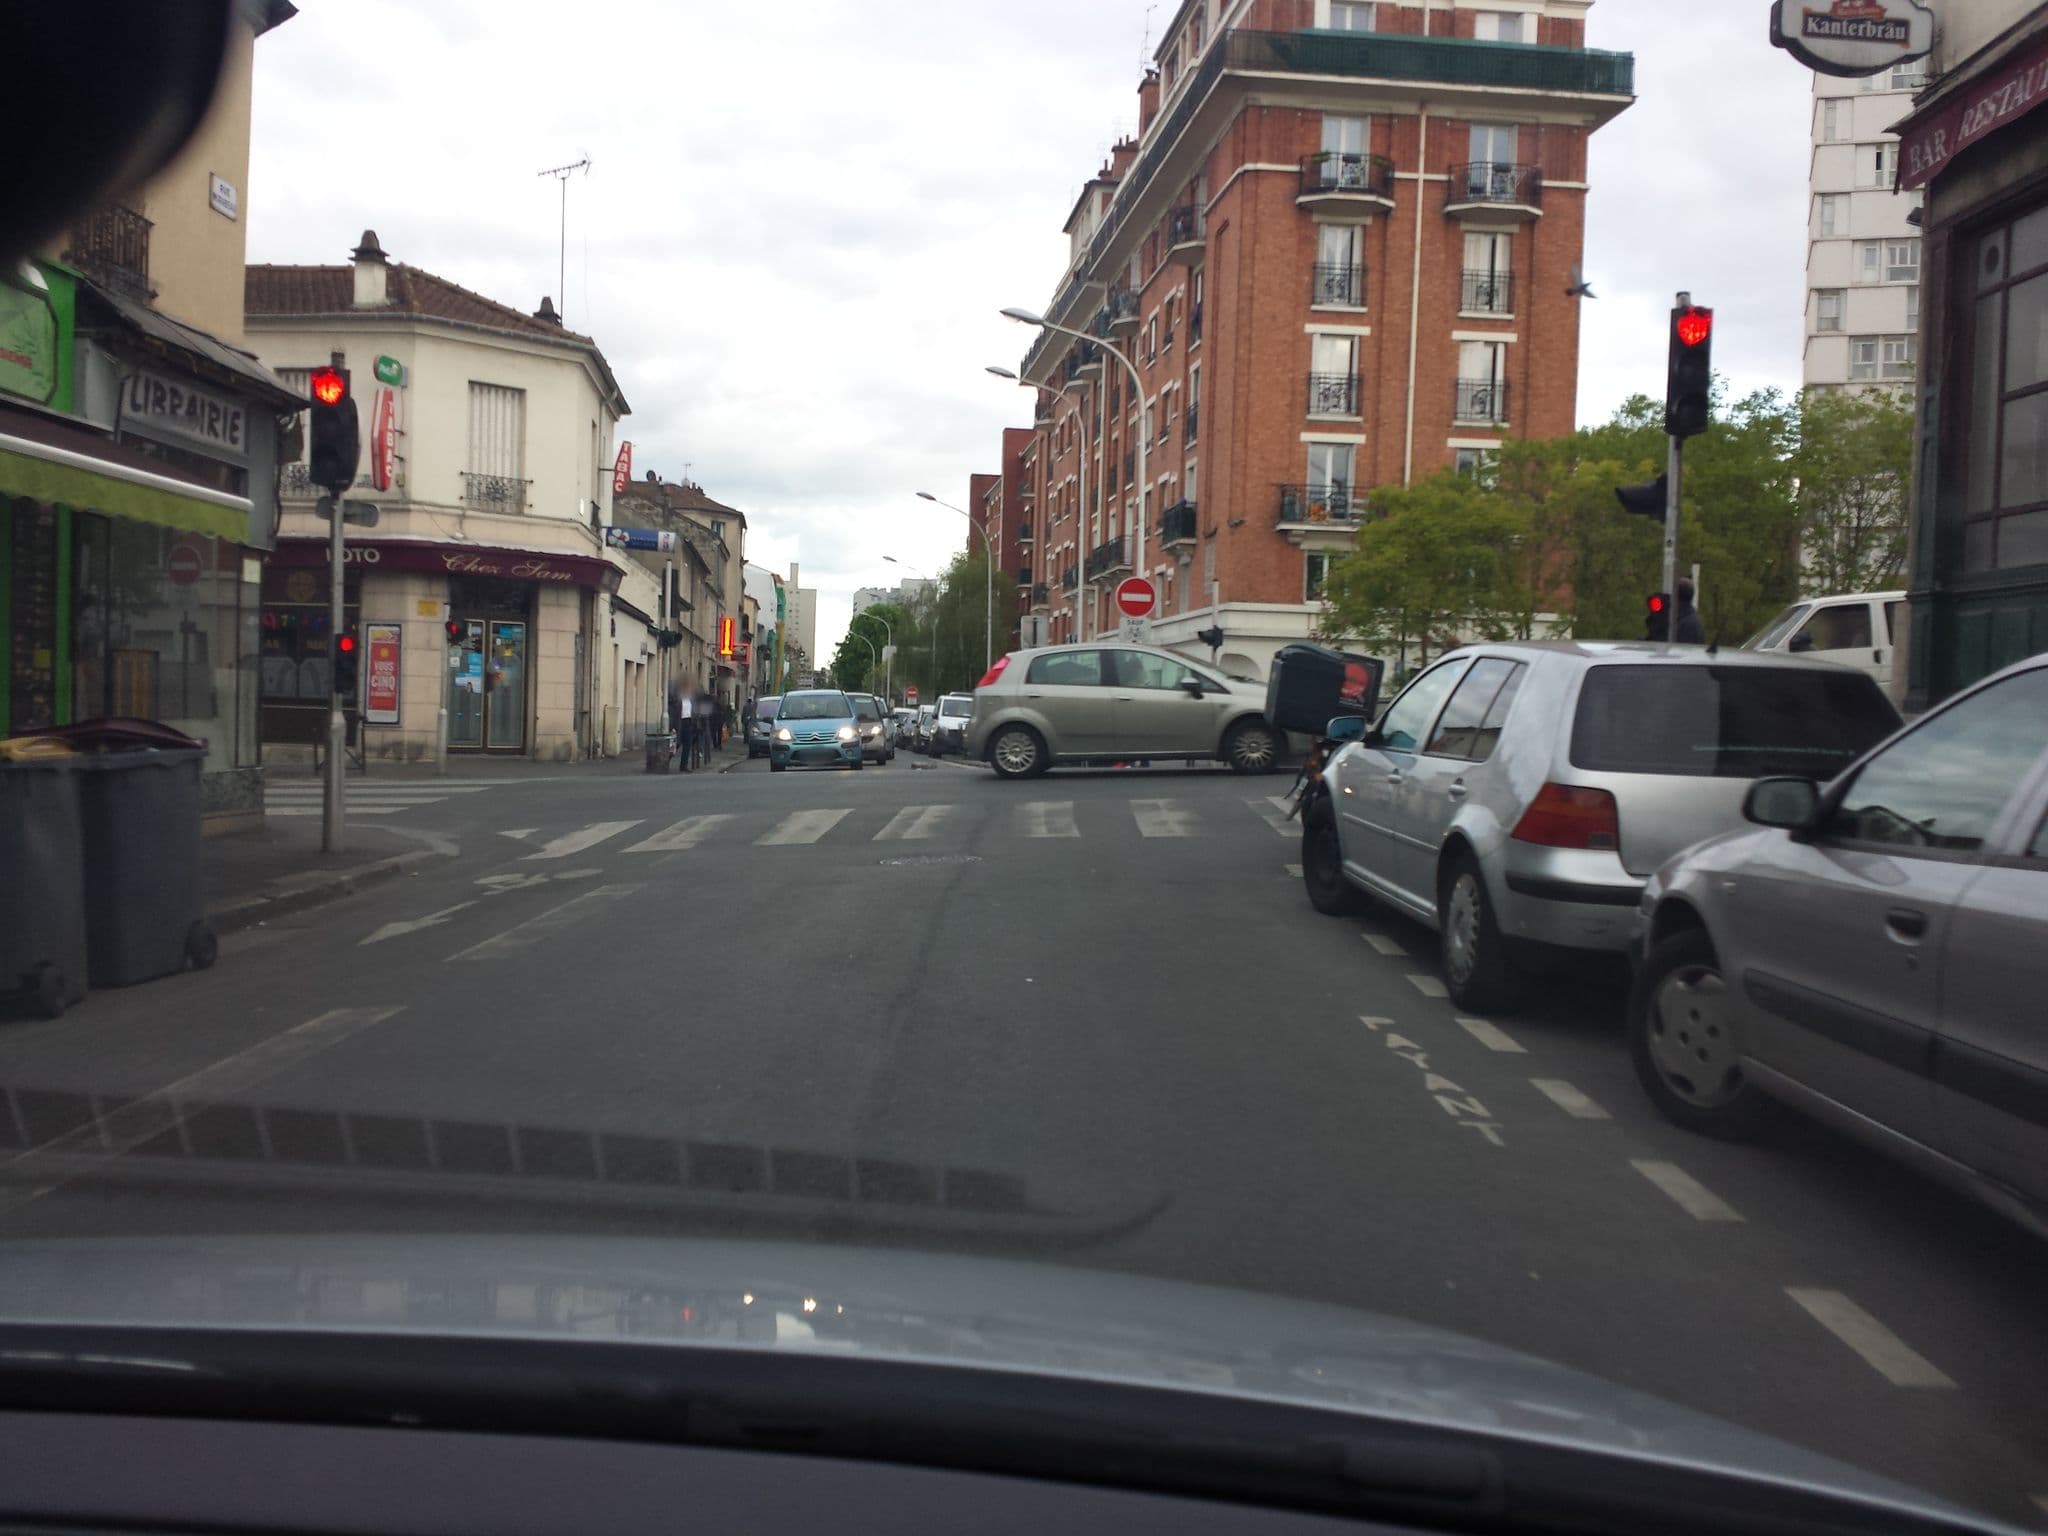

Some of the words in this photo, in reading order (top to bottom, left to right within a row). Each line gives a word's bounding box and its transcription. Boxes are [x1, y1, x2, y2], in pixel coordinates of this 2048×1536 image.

[1806, 15, 1906, 40] Kanterbräu
[1909, 129, 1948, 176] BAR
[129, 375, 241, 446] LIBRAIRIE
[385, 400, 395, 480] TABAC
[614, 441, 631, 493] TABAC
[441, 553, 502, 575] Chez
[511, 560, 573, 581] Sam
